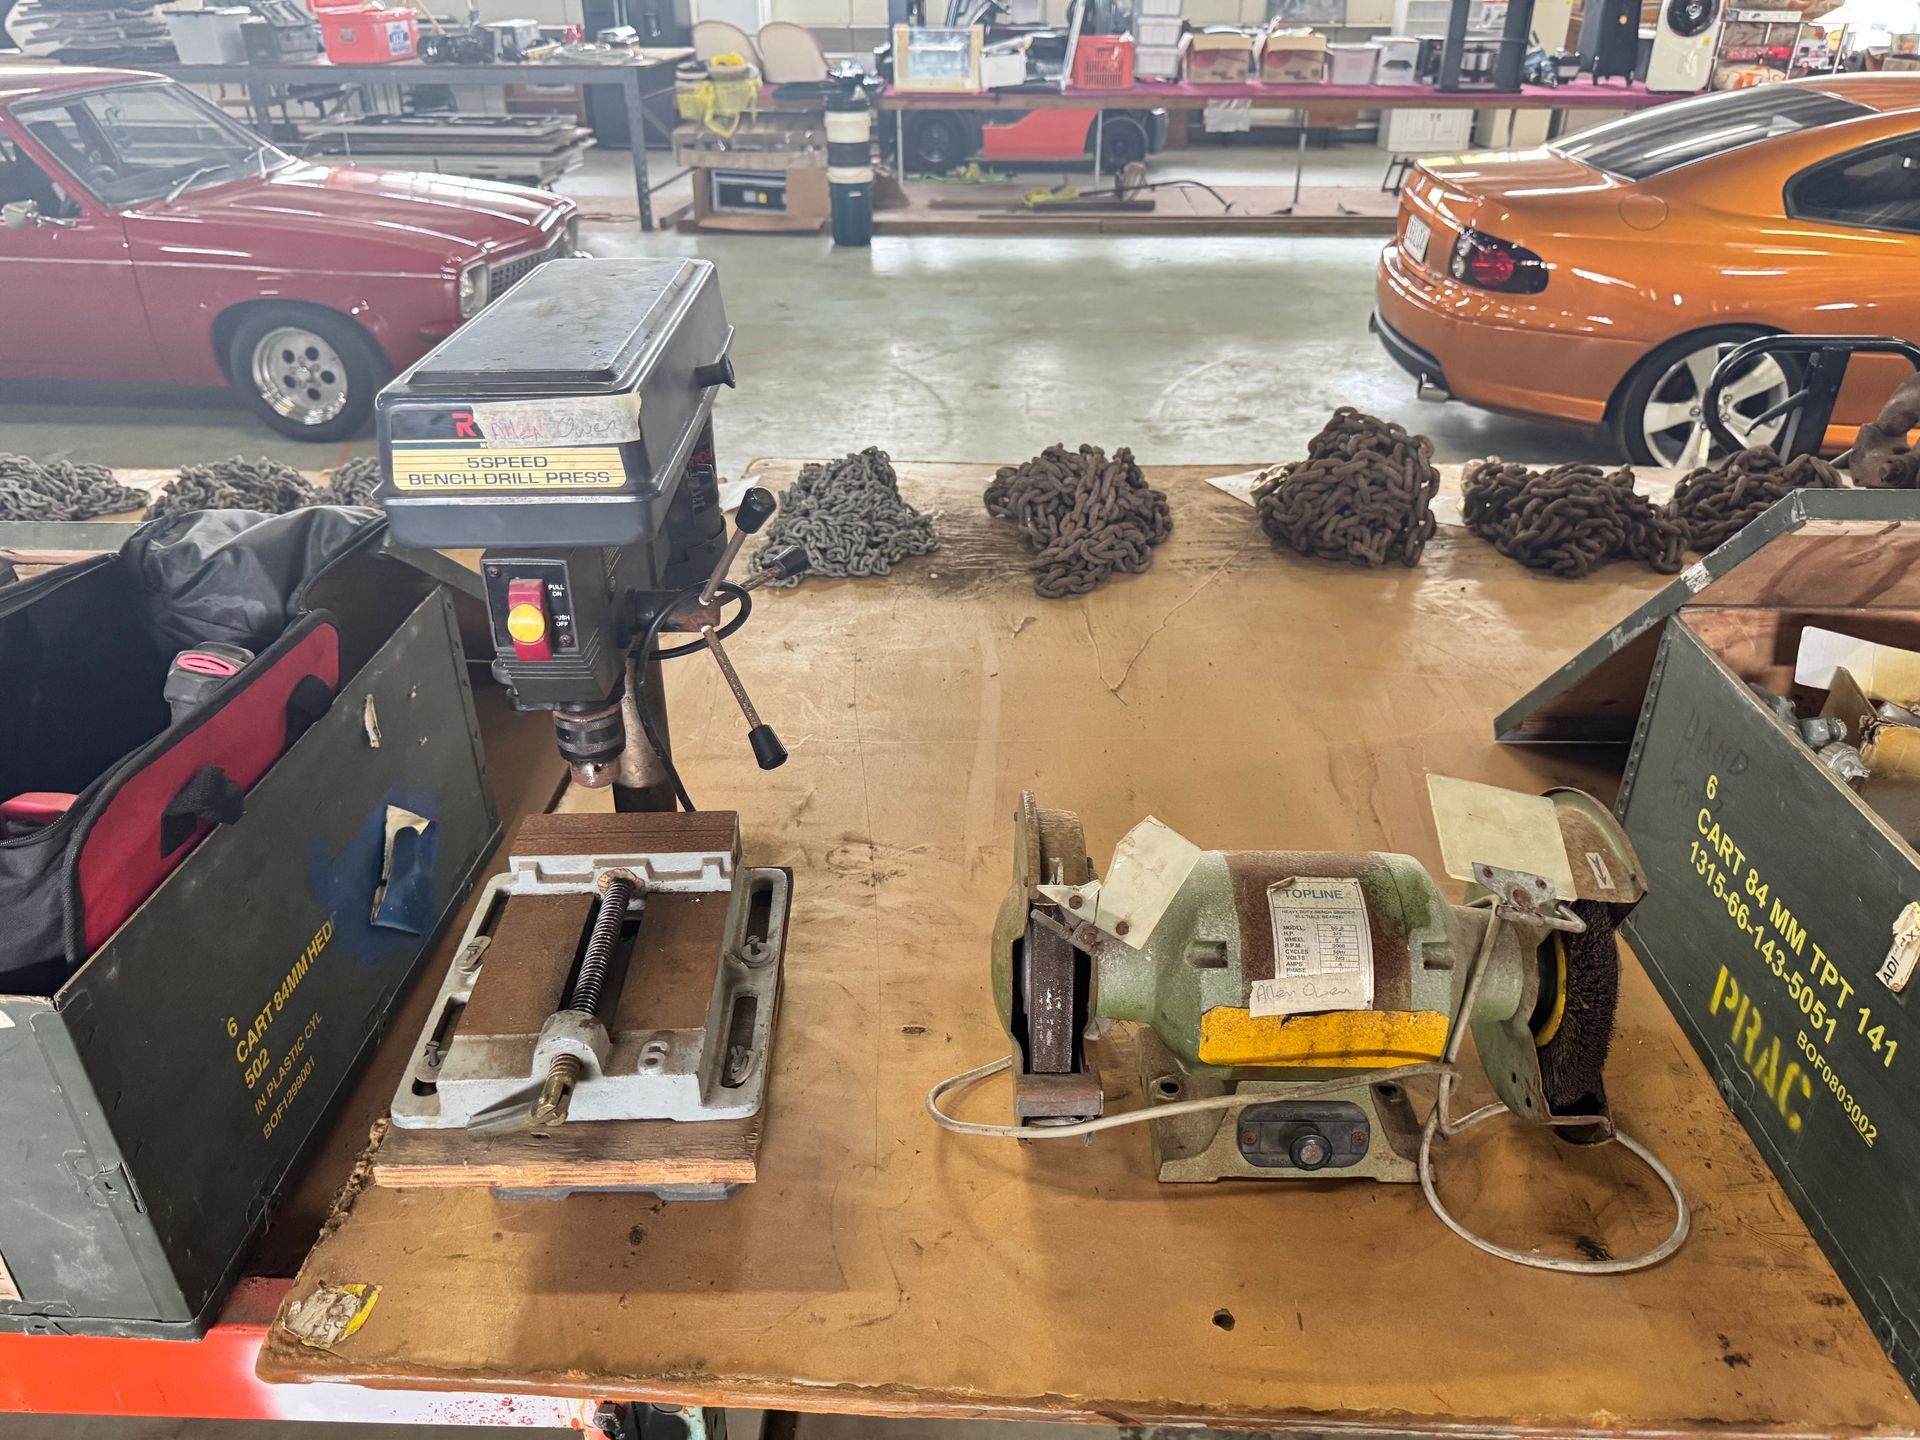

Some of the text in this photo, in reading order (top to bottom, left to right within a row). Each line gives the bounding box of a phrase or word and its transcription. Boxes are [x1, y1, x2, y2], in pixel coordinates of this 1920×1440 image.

[408, 471, 610, 486] BENCH DRILL PRESS
[466, 456, 548, 469] 5SPEED
[1706, 774, 1719, 800] 6
[1283, 888, 1344, 900] TOPLINE
[1690, 841, 1837, 1045] 1315-66-143-5051
[1698, 808, 1898, 1068] CART 84 MM TPT 141
[1882, 955, 1900, 985] ADI
[236, 919, 334, 1063] CART 84MM HED
[1255, 982, 1352, 1003] Allen Owen
[227, 1016, 239, 1038] 6
[254, 1011, 323, 1116] IN PLASTIC CYL
[638, 1040, 669, 1076] 6
[1709, 963, 1812, 1132] PRAC
[244, 1048, 271, 1089] 502
[1796, 1029, 1878, 1146] BOF0803002
[263, 1055, 317, 1140] BOF1299001
